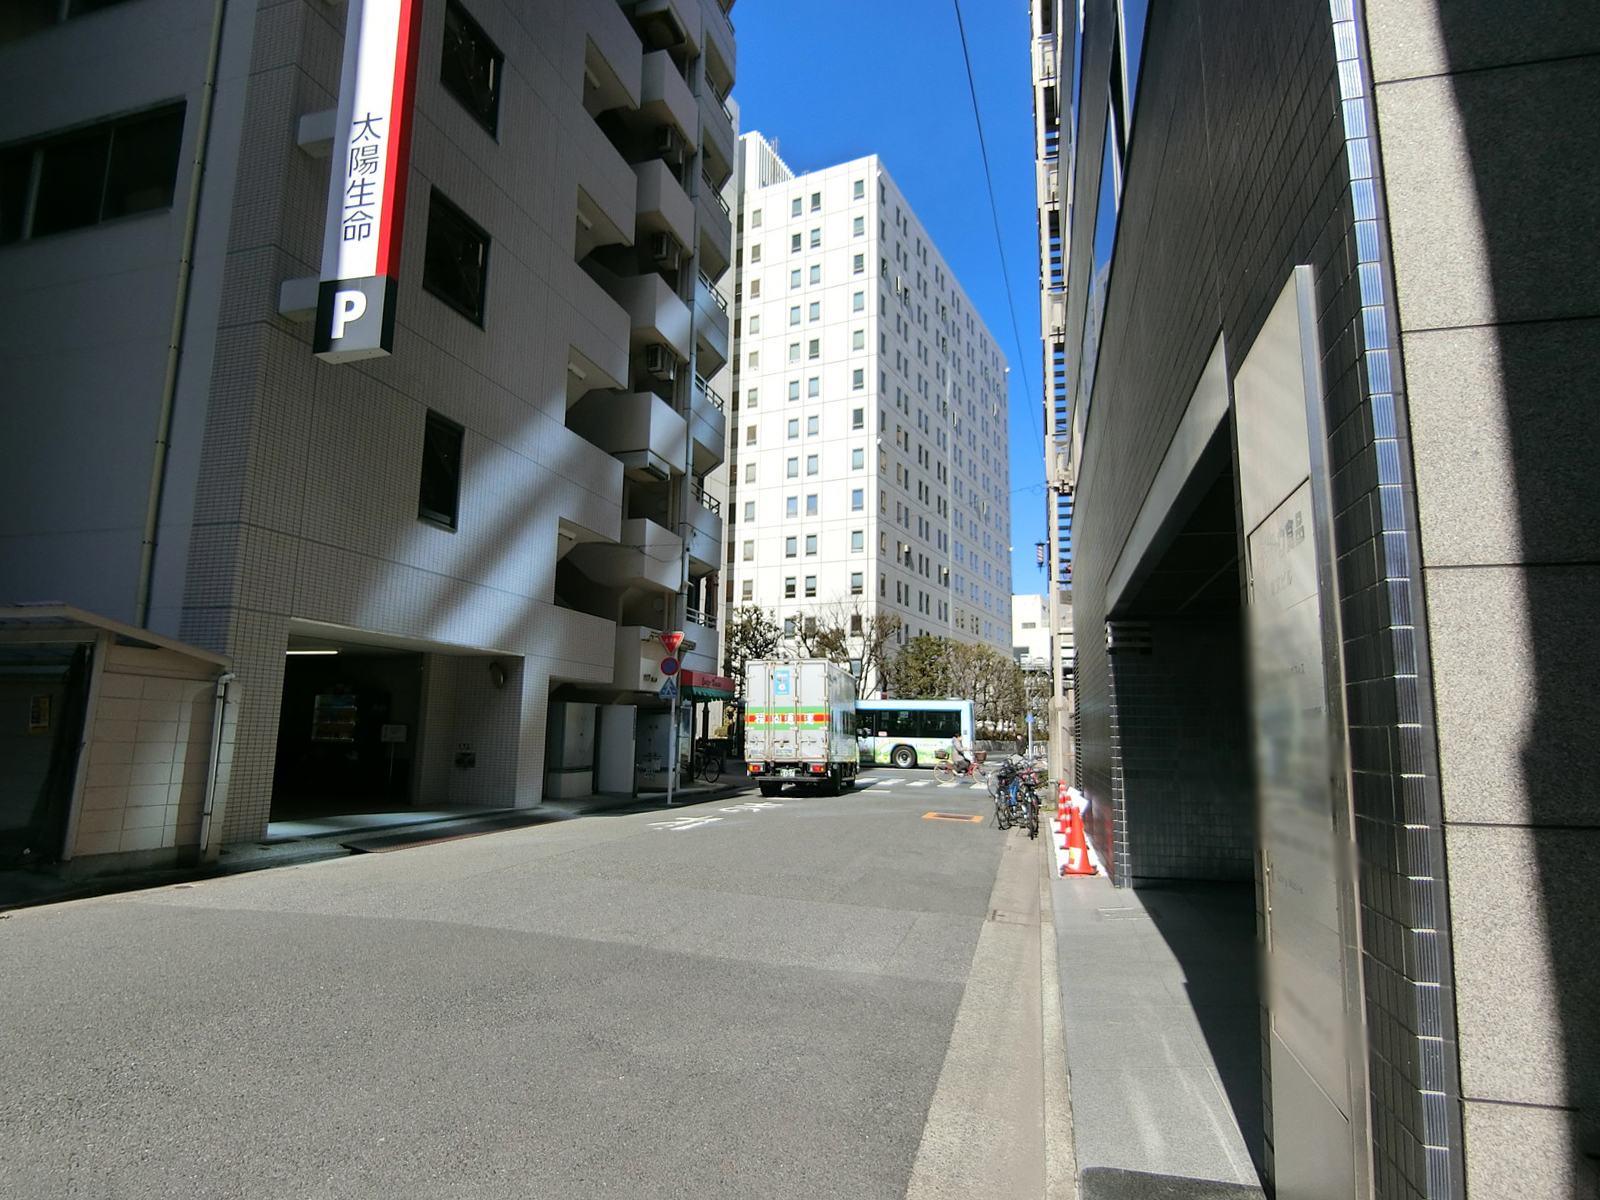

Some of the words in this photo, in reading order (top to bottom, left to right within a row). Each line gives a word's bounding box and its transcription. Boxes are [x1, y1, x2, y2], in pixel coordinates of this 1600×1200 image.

[343, 112, 383, 242] 太陽生命
[330, 289, 368, 340] P
